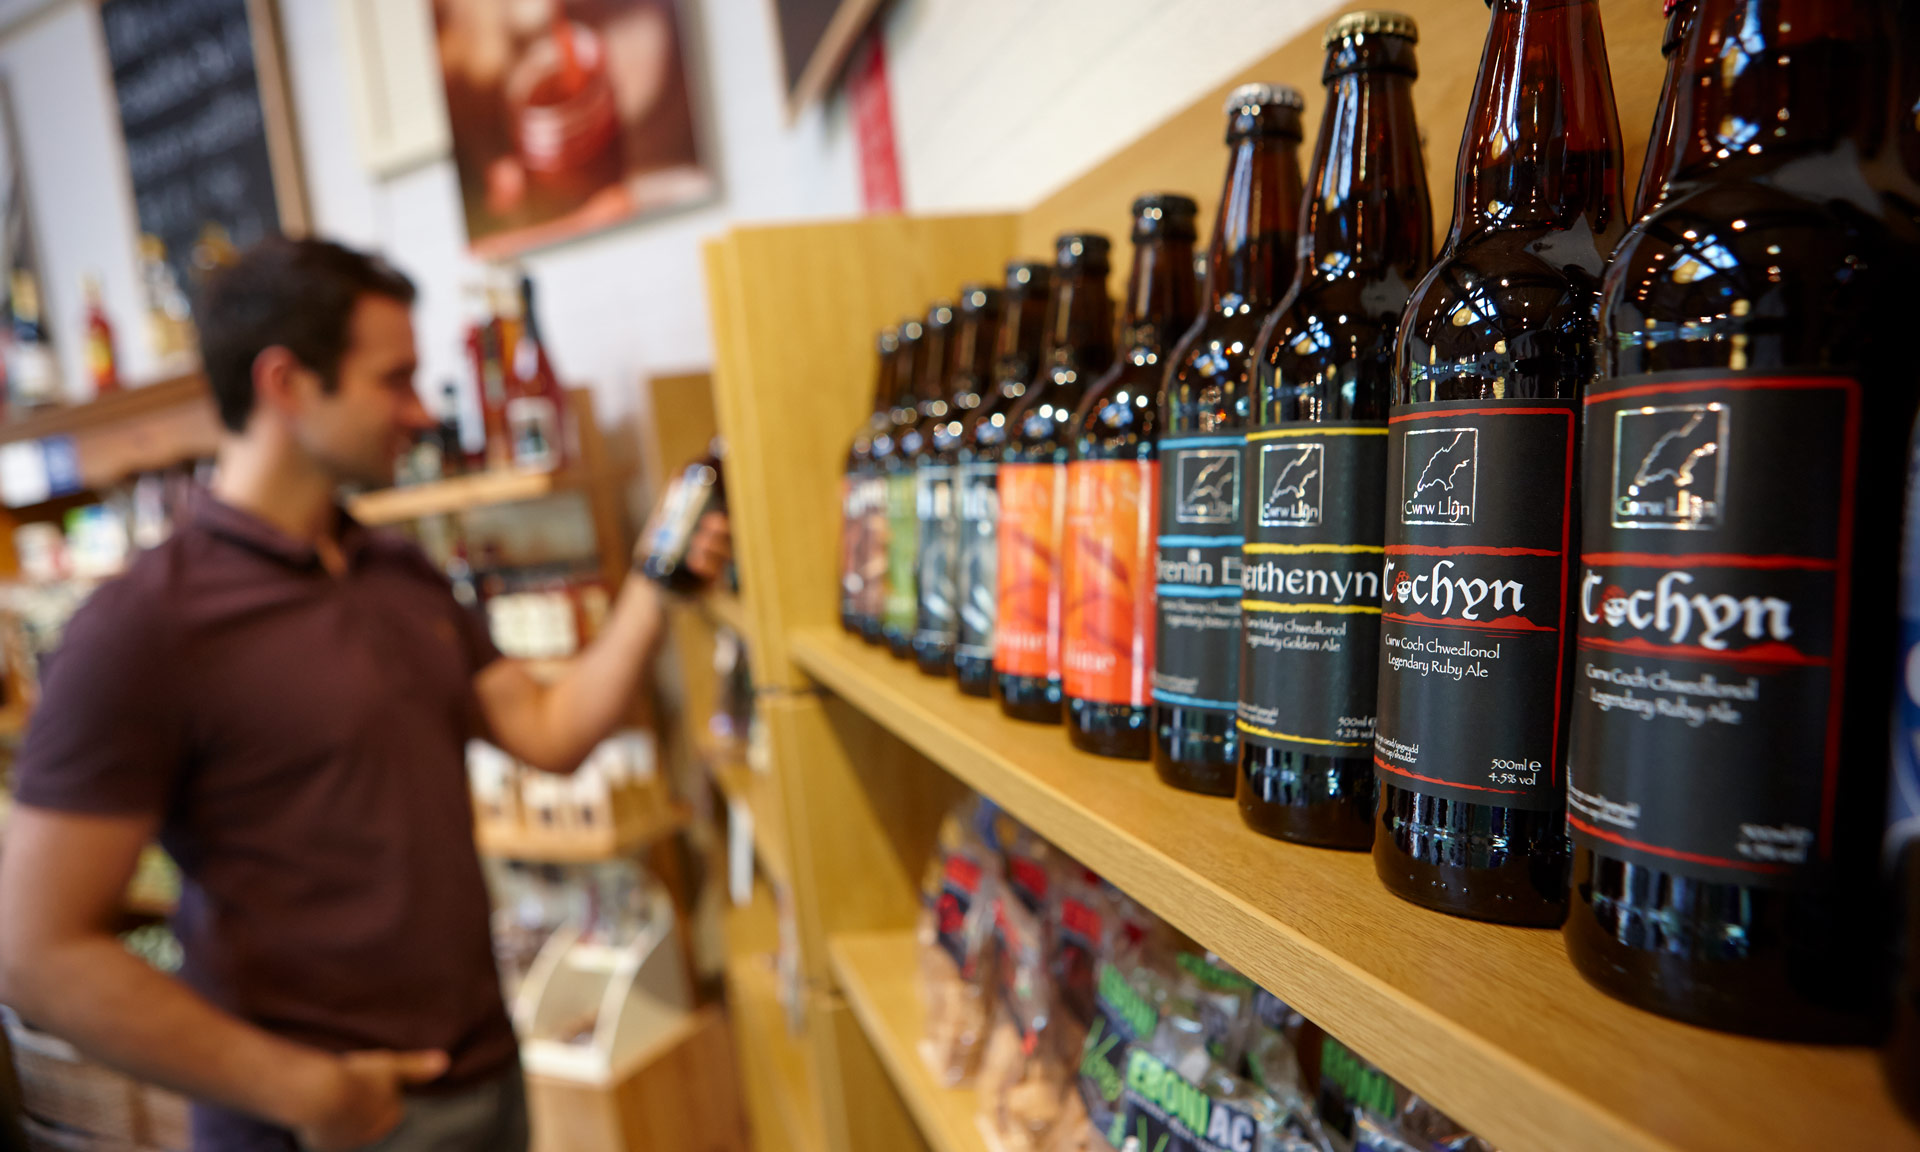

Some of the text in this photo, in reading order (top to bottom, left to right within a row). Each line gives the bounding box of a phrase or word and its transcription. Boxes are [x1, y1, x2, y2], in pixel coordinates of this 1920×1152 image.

[1404, 500, 1435, 515] Cwrw
[1284, 618, 1347, 637] Chwedlonol
[1283, 635, 1319, 650] Golden
[1320, 637, 1341, 652] Ale
[1401, 636, 1424, 651] Coch
[1426, 638, 1500, 659] Chwedlonol
[1388, 653, 1489, 681] Legendary Ruby Ale
[1491, 758, 1527, 771] 500ml
[1488, 772, 1536, 785] 4.5% vol
